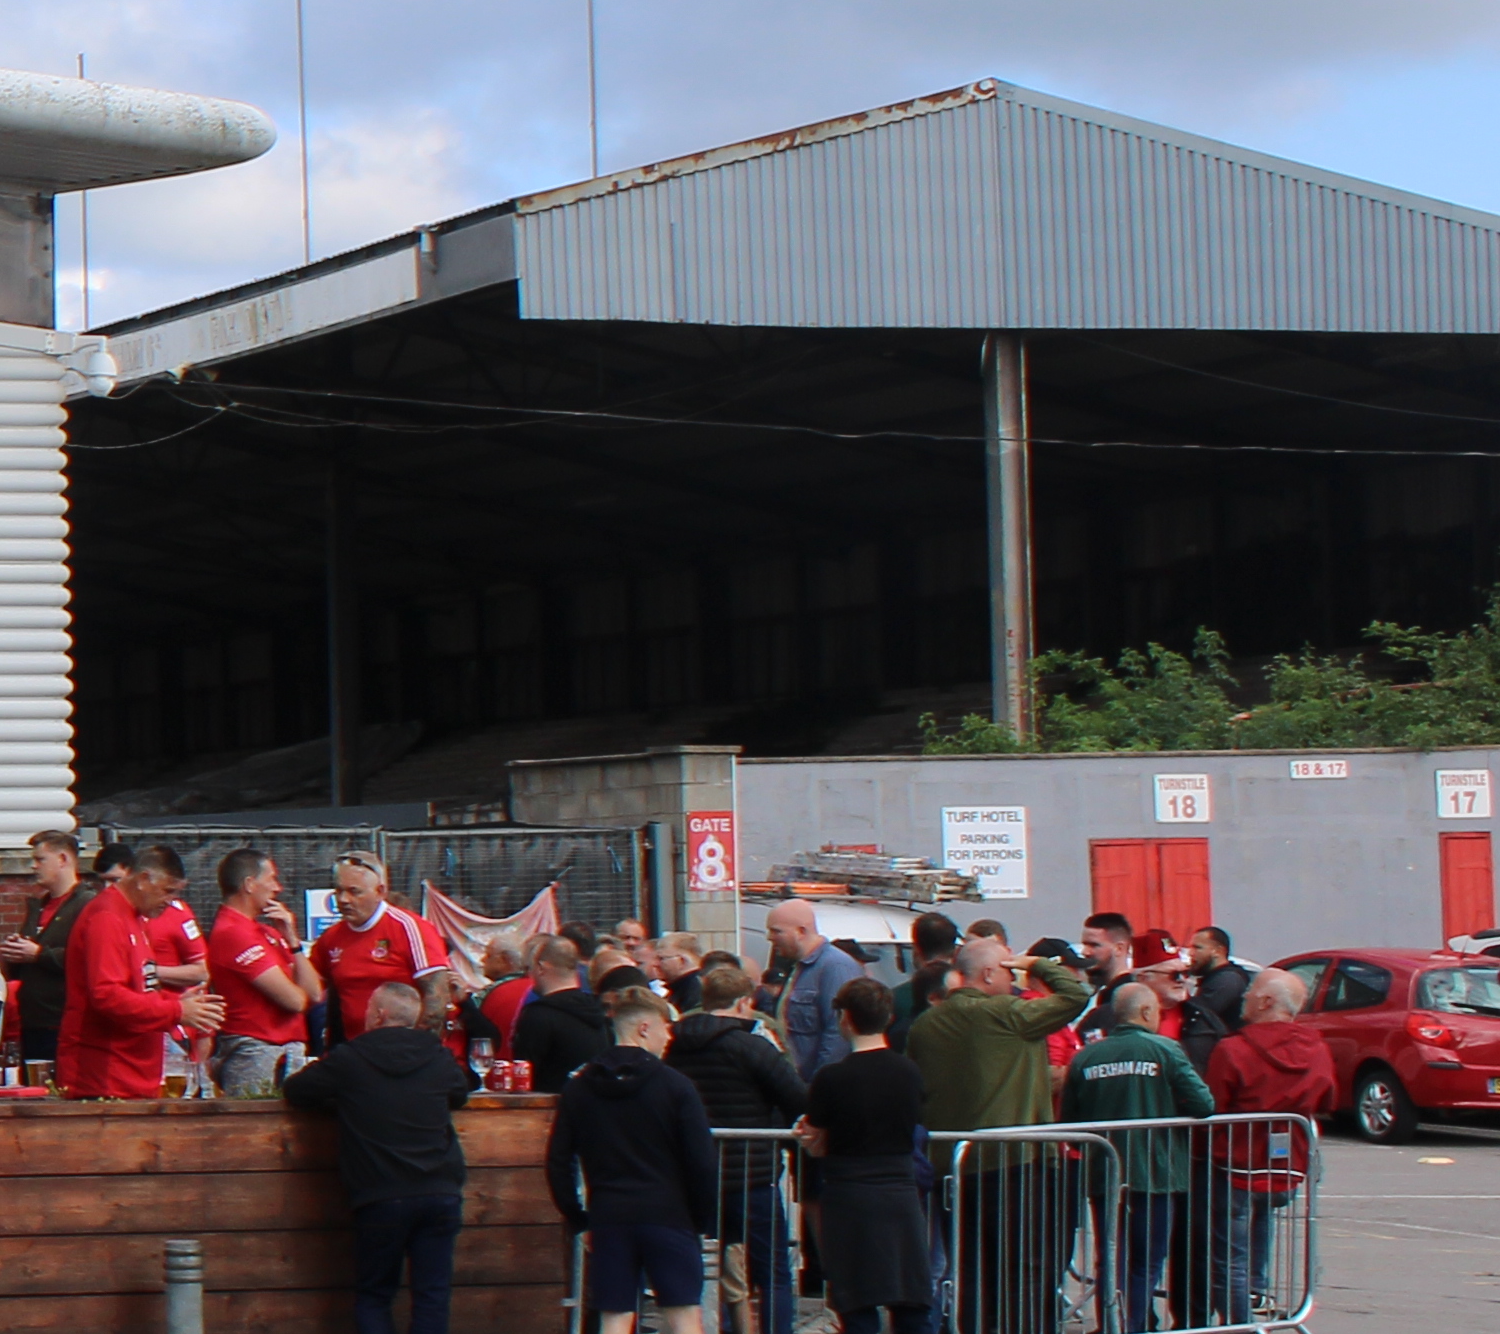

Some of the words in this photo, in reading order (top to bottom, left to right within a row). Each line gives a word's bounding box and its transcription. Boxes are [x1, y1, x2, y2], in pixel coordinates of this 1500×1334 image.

[1293, 763, 1310, 776] 18
[1313, 763, 1323, 776] &
[1328, 762, 1344, 775] 17
[1157, 778, 1205, 790] TURNSTILE
[1440, 774, 1486, 786] TURNSTILE
[1168, 795, 1196, 818] 18
[1450, 791, 1477, 814] 17
[945, 811, 978, 823] TURF
[980, 810, 1023, 823] HOTEL
[690, 818, 731, 832] GATE
[959, 833, 1010, 845] PARKING
[947, 849, 970, 861] FOR
[972, 849, 1024, 860] PATRONS
[698, 841, 725, 884] 8
[971, 865, 1000, 876] ONLY
[1135, 1061, 1158, 1077] AFC
